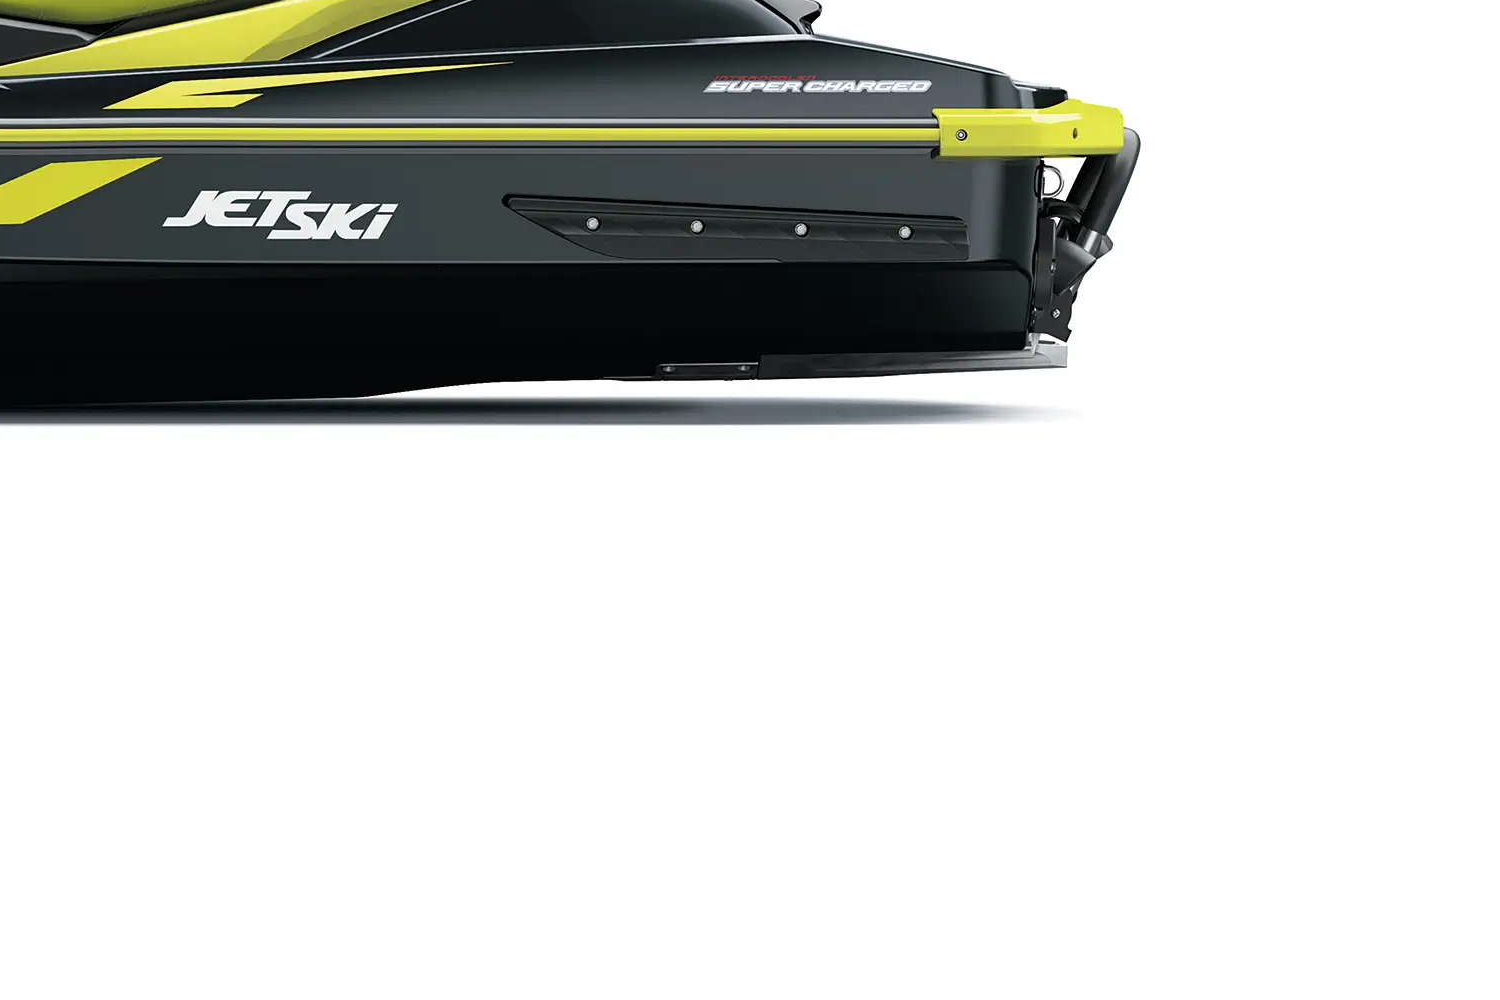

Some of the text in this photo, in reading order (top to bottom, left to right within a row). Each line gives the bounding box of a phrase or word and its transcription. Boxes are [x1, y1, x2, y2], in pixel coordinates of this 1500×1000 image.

[703, 80, 932, 93] SUPER CHARGED
[162, 190, 312, 227] JET
